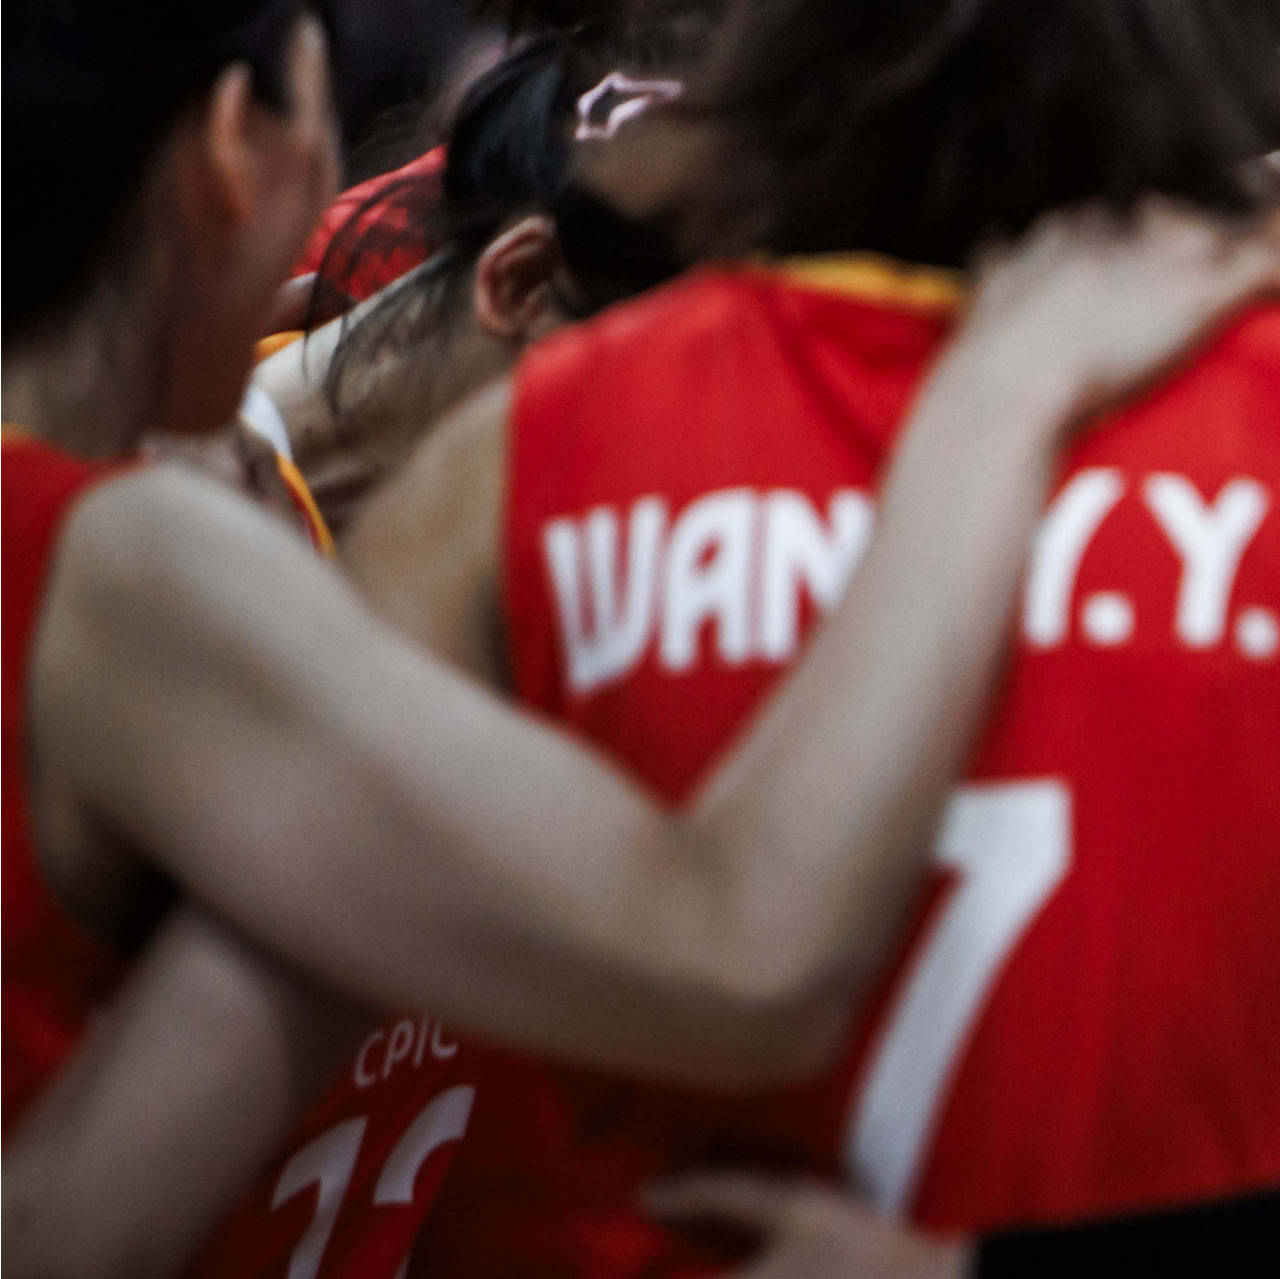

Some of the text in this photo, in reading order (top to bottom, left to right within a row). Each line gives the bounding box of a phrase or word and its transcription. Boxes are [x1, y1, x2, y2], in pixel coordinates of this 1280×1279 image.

[545, 488, 876, 692] WAN
[354, 1012, 459, 1088] CPIC
[843, 775, 1072, 1222] 7
